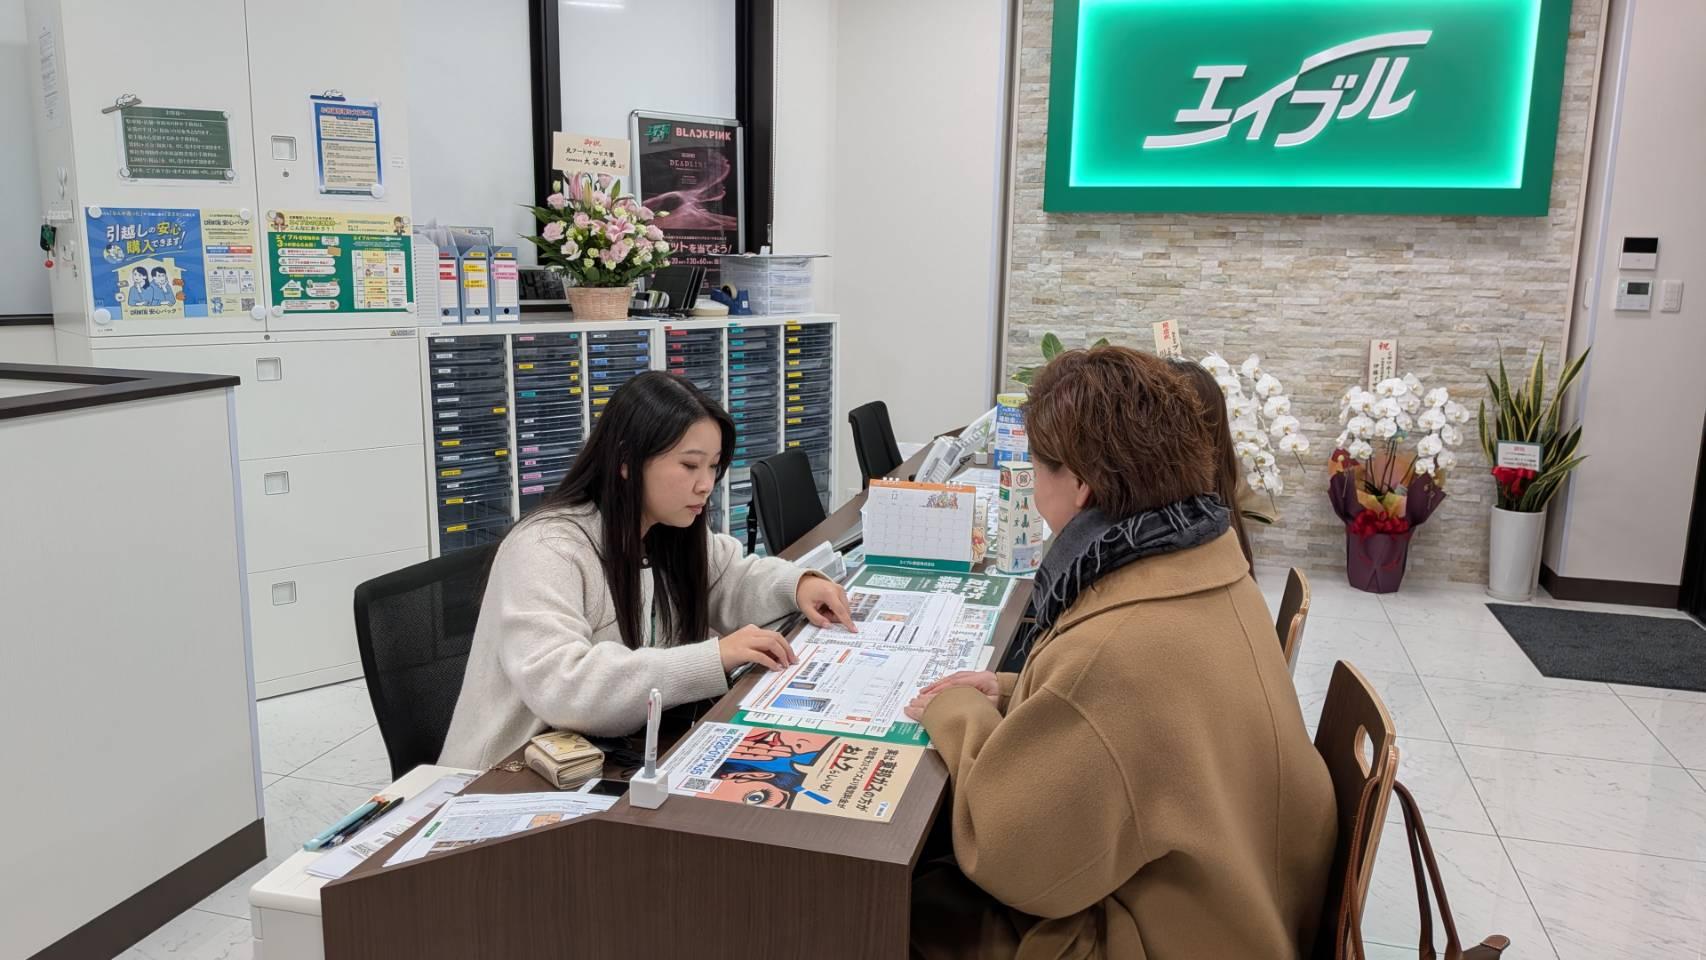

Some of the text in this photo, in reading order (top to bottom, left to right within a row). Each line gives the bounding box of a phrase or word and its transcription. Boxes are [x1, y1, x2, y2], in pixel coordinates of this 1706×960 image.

[1142, 30, 1433, 149] エイブル
[676, 127, 732, 141] BLACKPINK
[106, 222, 183, 242] 引越しの安心
